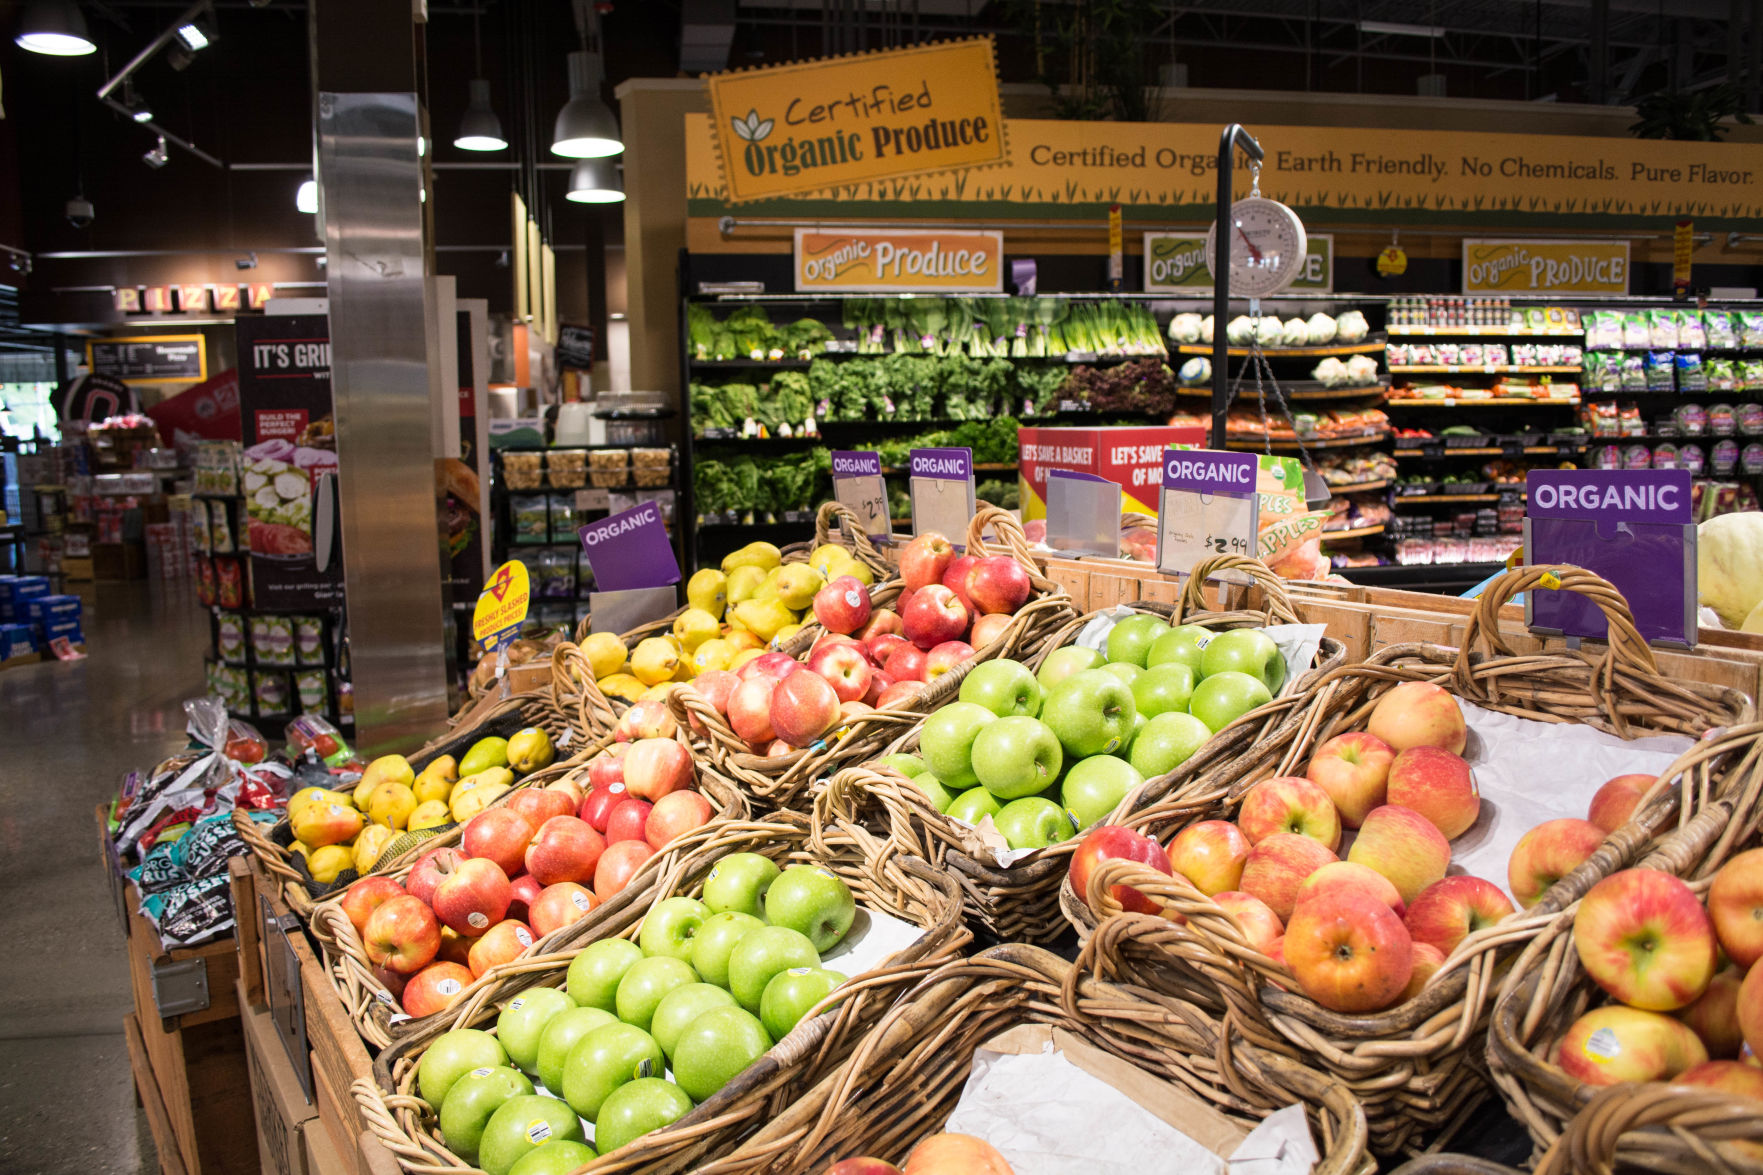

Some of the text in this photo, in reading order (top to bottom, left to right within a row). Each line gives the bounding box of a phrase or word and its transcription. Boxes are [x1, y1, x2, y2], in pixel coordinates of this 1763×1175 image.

[785, 80, 932, 126] Certified
[744, 115, 989, 177] Organic Produce
[1030, 144, 1754, 185] Certified Orgaic Earth Friendly. No Chemicals. Pure Flavor.
[805, 239, 988, 280] Organic Produce
[1152, 239, 1207, 282] Organi
[1530, 255, 1625, 289] PRODUCE
[119, 284, 272, 311] PIZZA
[253, 343, 290, 369] IT'S
[259, 412, 302, 421] BUILD THE
[259, 420, 296, 428] PERFECT
[834, 457, 878, 473] ORGANIC
[913, 457, 965, 475] ORGANIC
[1021, 444, 1093, 465] LET'S SAVE A BASKET
[1111, 444, 1163, 465] LET'S SAVE
[1034, 465, 1044, 483] OF
[1132, 468, 1147, 487] OF
[1167, 459, 1251, 484] ORGANIC
[1534, 484, 1681, 511] ORGANIC
[585, 508, 657, 546] ORGANIC
[474, 592, 528, 629] FRESHLY SLASHED
